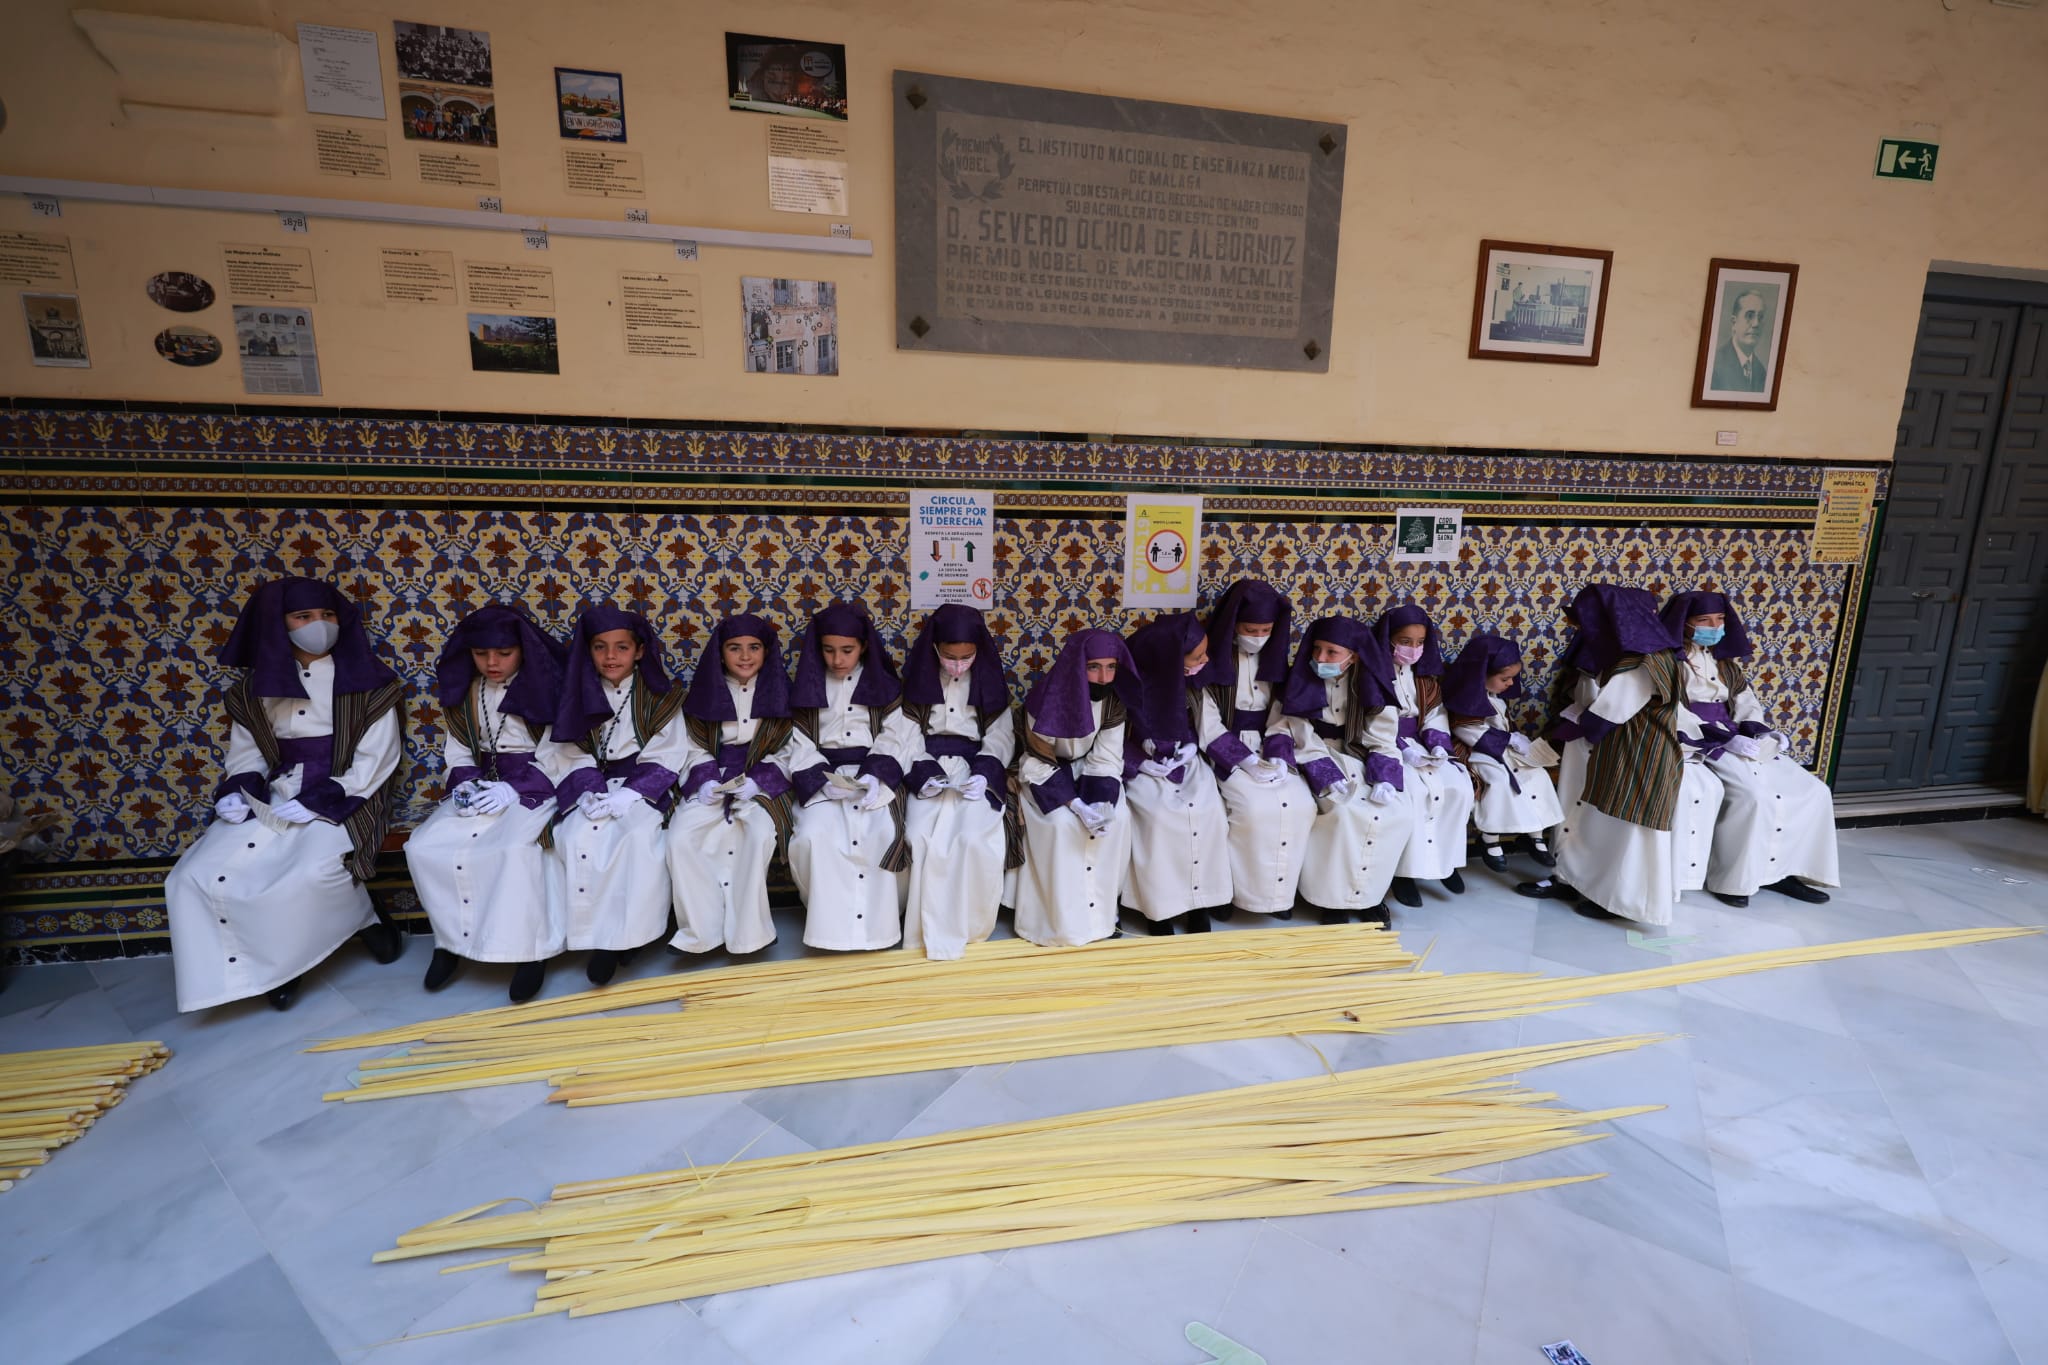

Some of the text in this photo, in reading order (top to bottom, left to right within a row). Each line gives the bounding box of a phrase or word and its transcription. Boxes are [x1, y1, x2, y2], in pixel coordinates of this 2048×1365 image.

[957, 137, 992, 154] PREMIO
[1018, 137, 1305, 184] EL INSTITUTO NACIONAL DE ENSEÑANZA MEDIA
[956, 156, 991, 173] NOBEL
[1130, 168, 1145, 185] DE
[1065, 200, 1259, 230] SU BACHILLERATO EN ESTE CENTRO
[1074, 182, 1094, 195] CON
[1095, 185, 1120, 200] ESTA
[1121, 188, 1153, 204] PLACA
[1154, 191, 1167, 205] EL
[1168, 193, 1215, 210] RECUERDO
[1216, 197, 1230, 211] DE
[1231, 199, 1261, 214] HABER
[1262, 202, 1304, 218] CURSADO
[283, 218, 303, 230] 1878
[946, 206, 1297, 268] D. SEVERO OCHOA DE ALBORNOZ
[946, 244, 1294, 289] PREMIO NOBEL DE MEDICINA MCMLIX
[968, 269, 1007, 283] DICHO
[1010, 272, 1027, 285] DE
[1030, 273, 1062, 288] ESTE
[1065, 276, 1126, 292] INSTITUTO
[1236, 288, 1260, 301] LAS
[1263, 290, 1300, 302] ENSE-
[966, 297, 1035, 312] EDUARDO
[1159, 312, 1167, 321] A
[1172, 311, 1212, 325] QUIEN
[1216, 314, 1257, 327] TANTO
[1005, 286, 1024, 297] DE
[1027, 289, 1089, 304] ALGUNOS
[1091, 292, 1109, 304] DE
[1112, 293, 1138, 305] MIS
[1140, 295, 1202, 310] MAESTROS
[1222, 302, 1294, 316] PARTICULAR
[919, 506, 987, 517] SIEMPRE POR
[930, 496, 976, 506] CIRCULA
[920, 516, 984, 527] TU DERECHA
